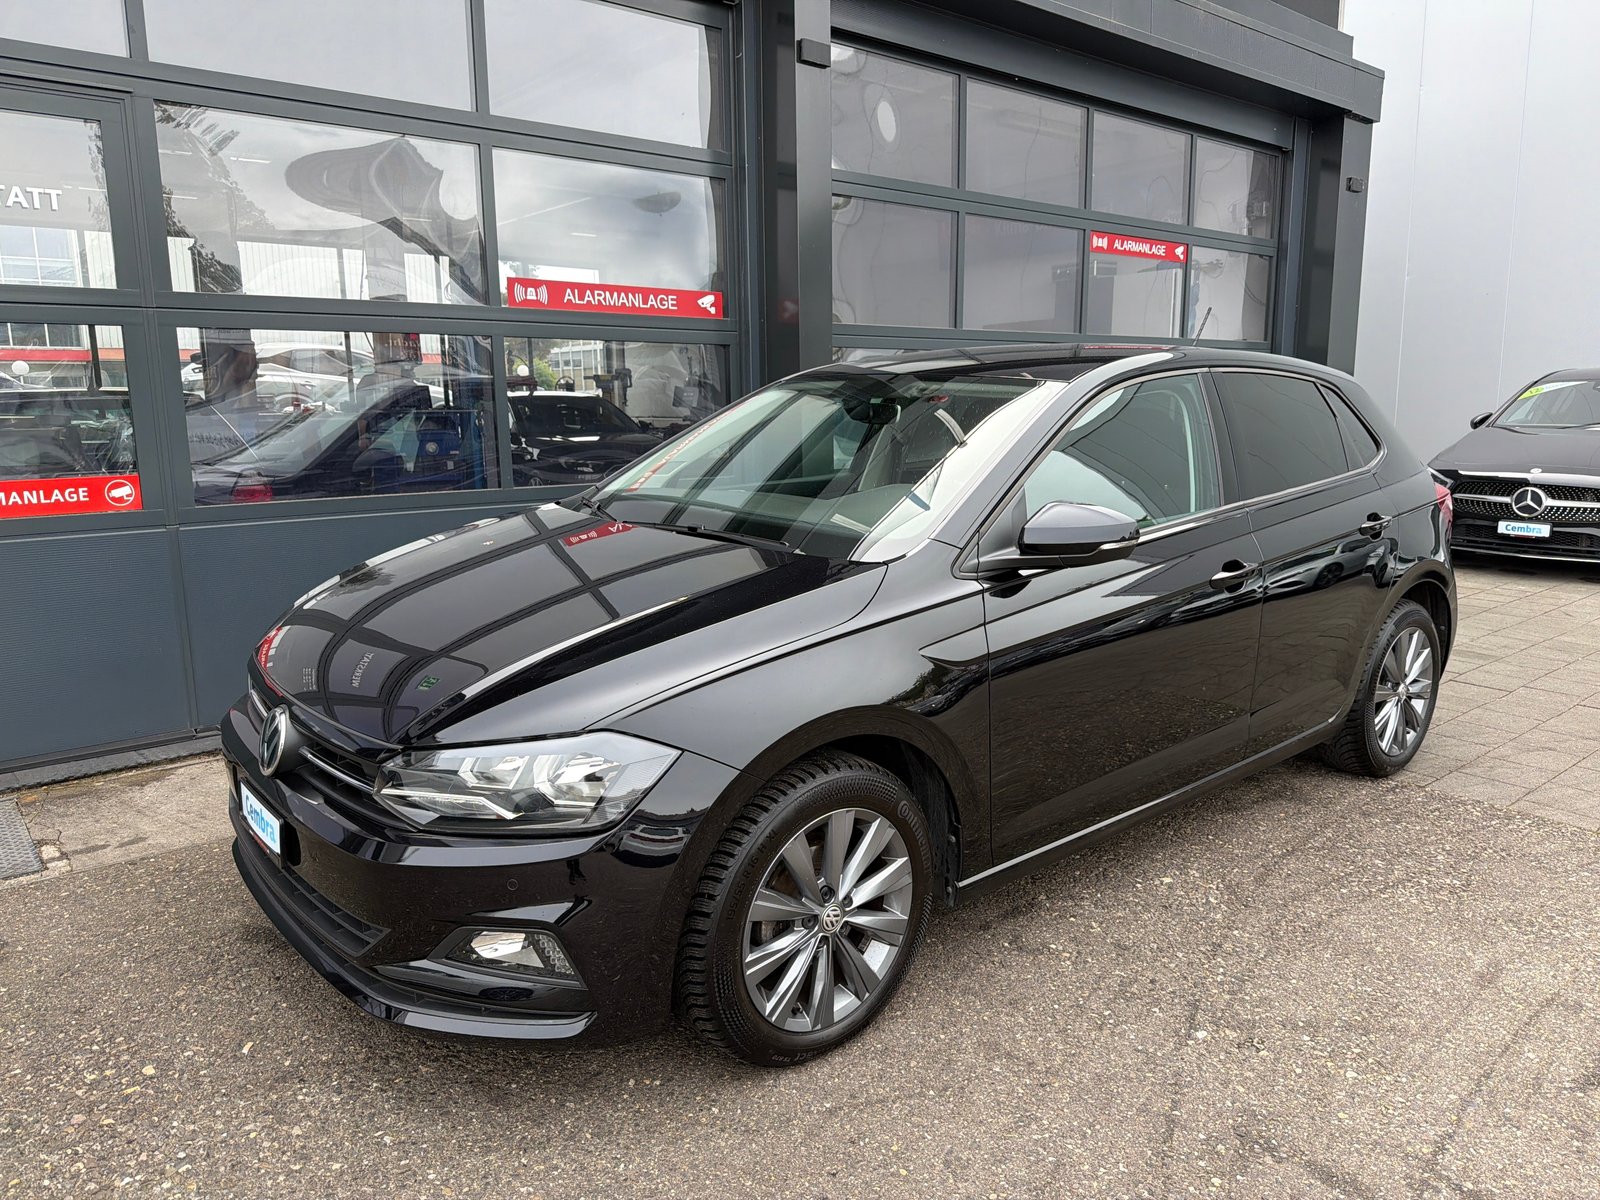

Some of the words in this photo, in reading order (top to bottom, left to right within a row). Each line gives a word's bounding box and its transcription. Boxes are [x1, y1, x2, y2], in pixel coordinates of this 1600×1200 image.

[1113, 238, 1166, 256] ALARMANLAGE
[563, 287, 678, 311] ALARMANLAGE
[1504, 523, 1543, 535] Cembra
[245, 794, 277, 844] Cembra
